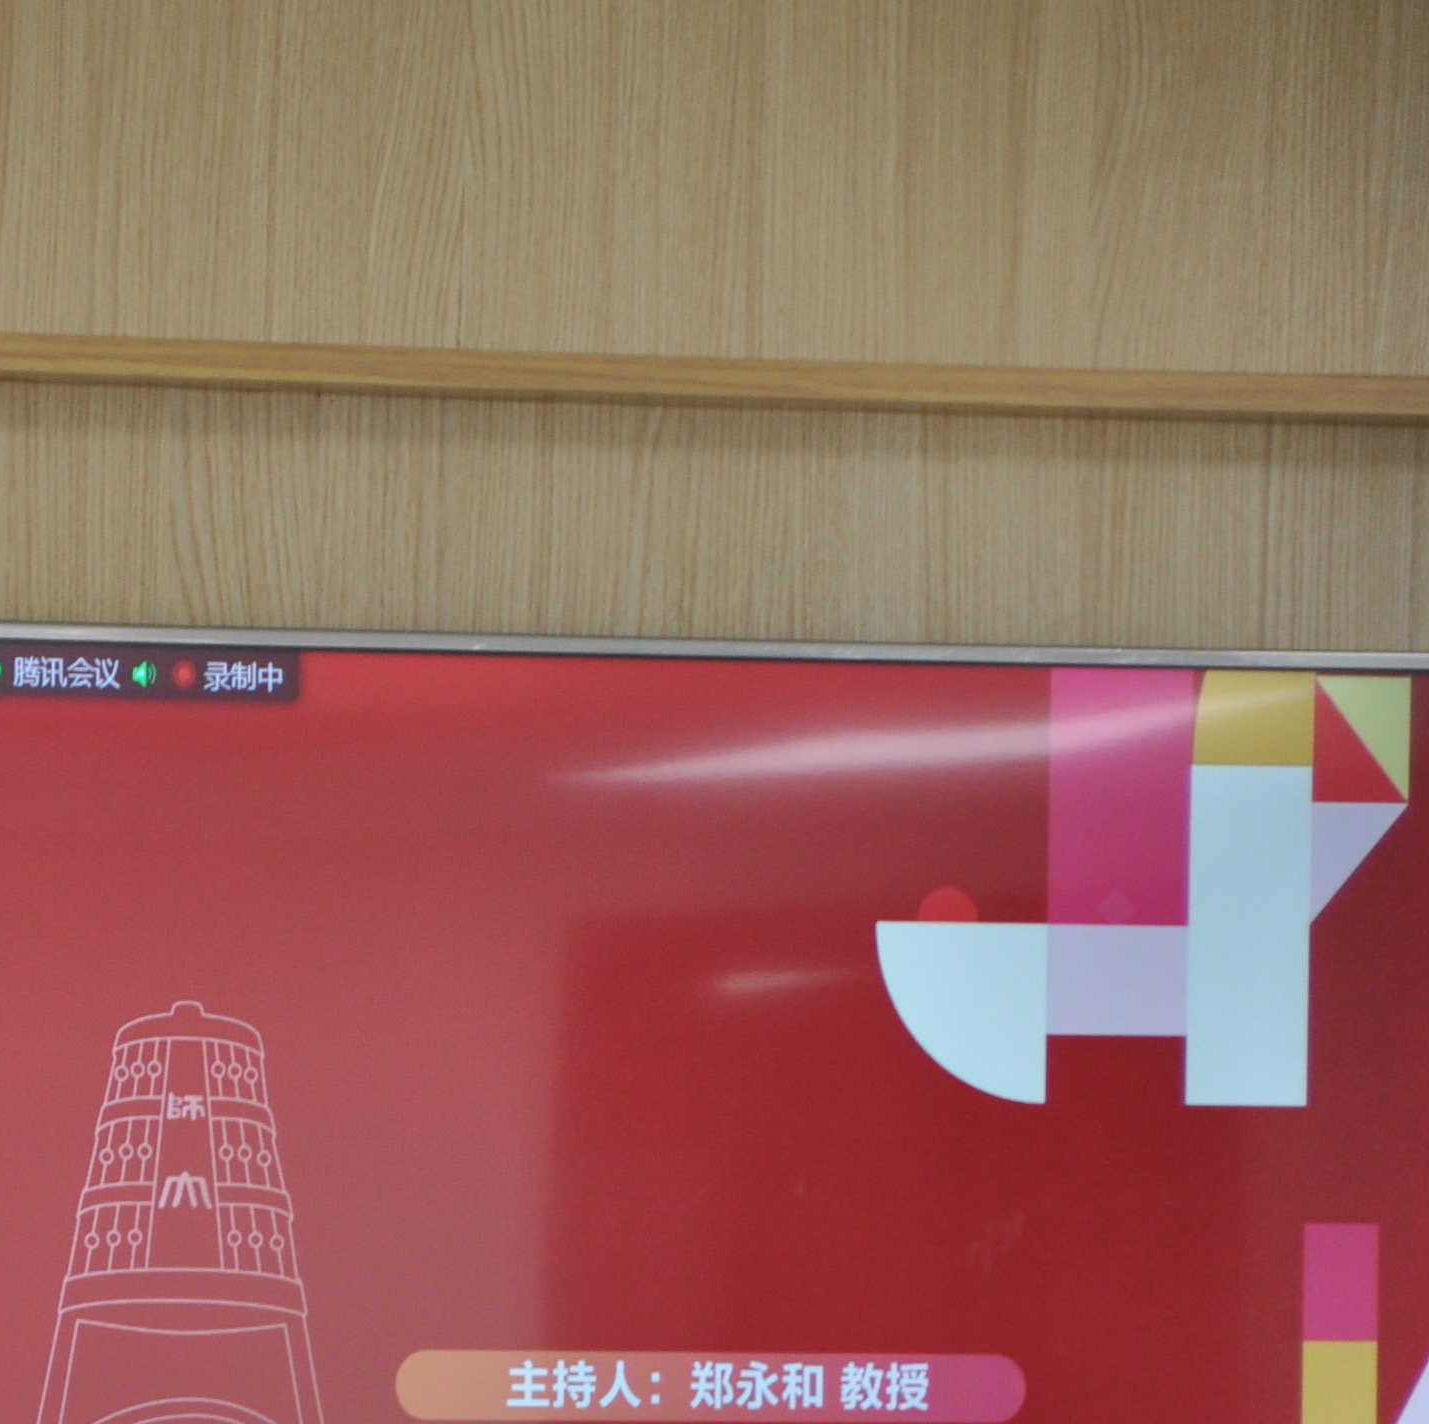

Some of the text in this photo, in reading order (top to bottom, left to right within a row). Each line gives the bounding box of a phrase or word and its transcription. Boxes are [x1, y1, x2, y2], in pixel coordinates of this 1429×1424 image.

[12, 657, 121, 689] 腾讯会议
[203, 661, 284, 693] 录制中
[840, 1362, 930, 1411] 教授
